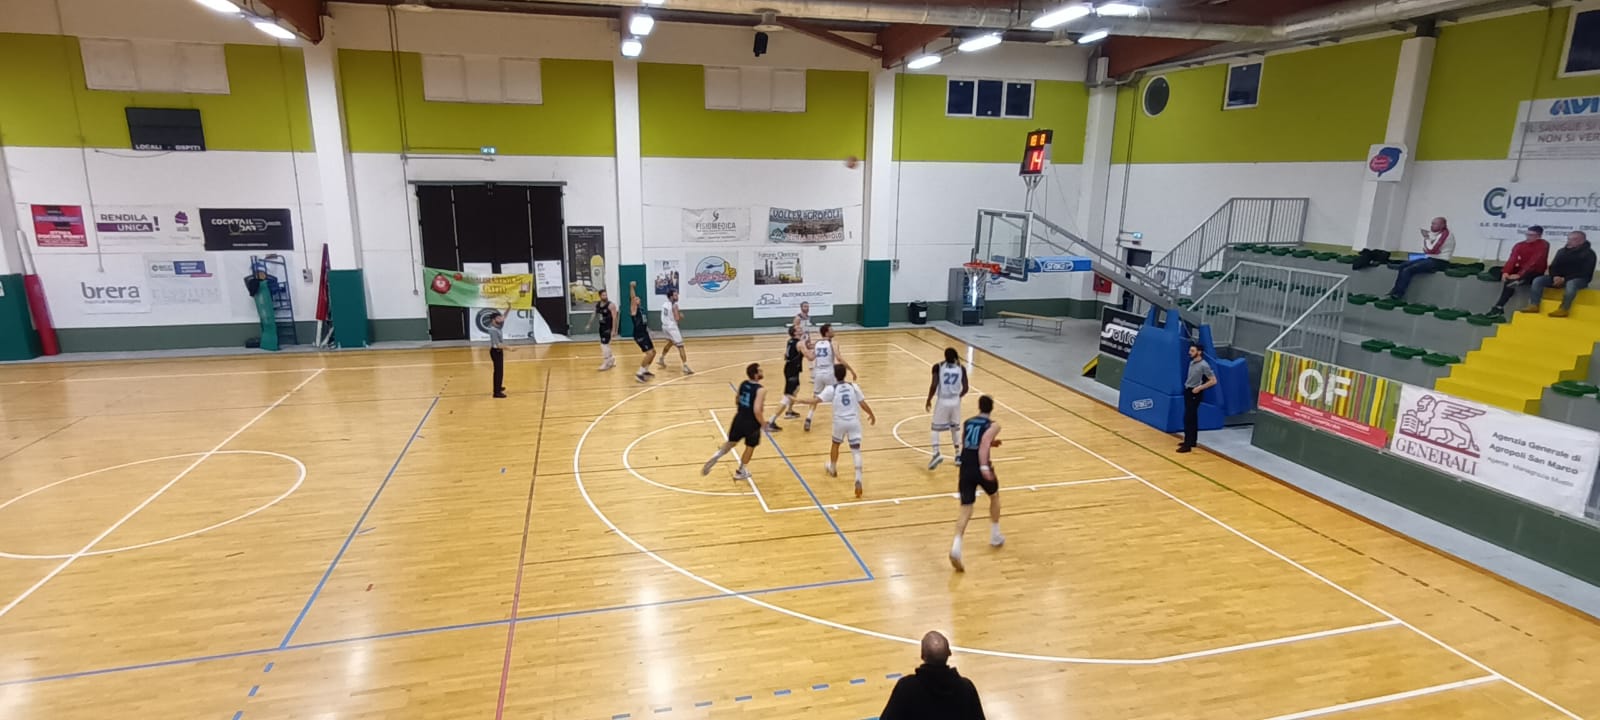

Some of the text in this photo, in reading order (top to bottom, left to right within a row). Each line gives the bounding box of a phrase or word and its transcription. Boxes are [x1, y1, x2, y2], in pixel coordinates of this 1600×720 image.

[1537, 133, 1562, 143] NON
[1566, 132, 1576, 142] SI
[100, 213, 148, 221] RENDILA
[772, 209, 801, 220] VOLLEY
[116, 223, 150, 231] UNICA
[211, 218, 254, 226] COCKTAIL
[80, 281, 141, 299] brera
[943, 372, 959, 385] 27
[1298, 368, 1351, 406] OF
[841, 394, 851, 407] 6
[1491, 430, 1582, 463] Agenzia Generale di
[1395, 437, 1479, 476] GENERALI
[1489, 443, 1579, 475] Agropoli San Marco
